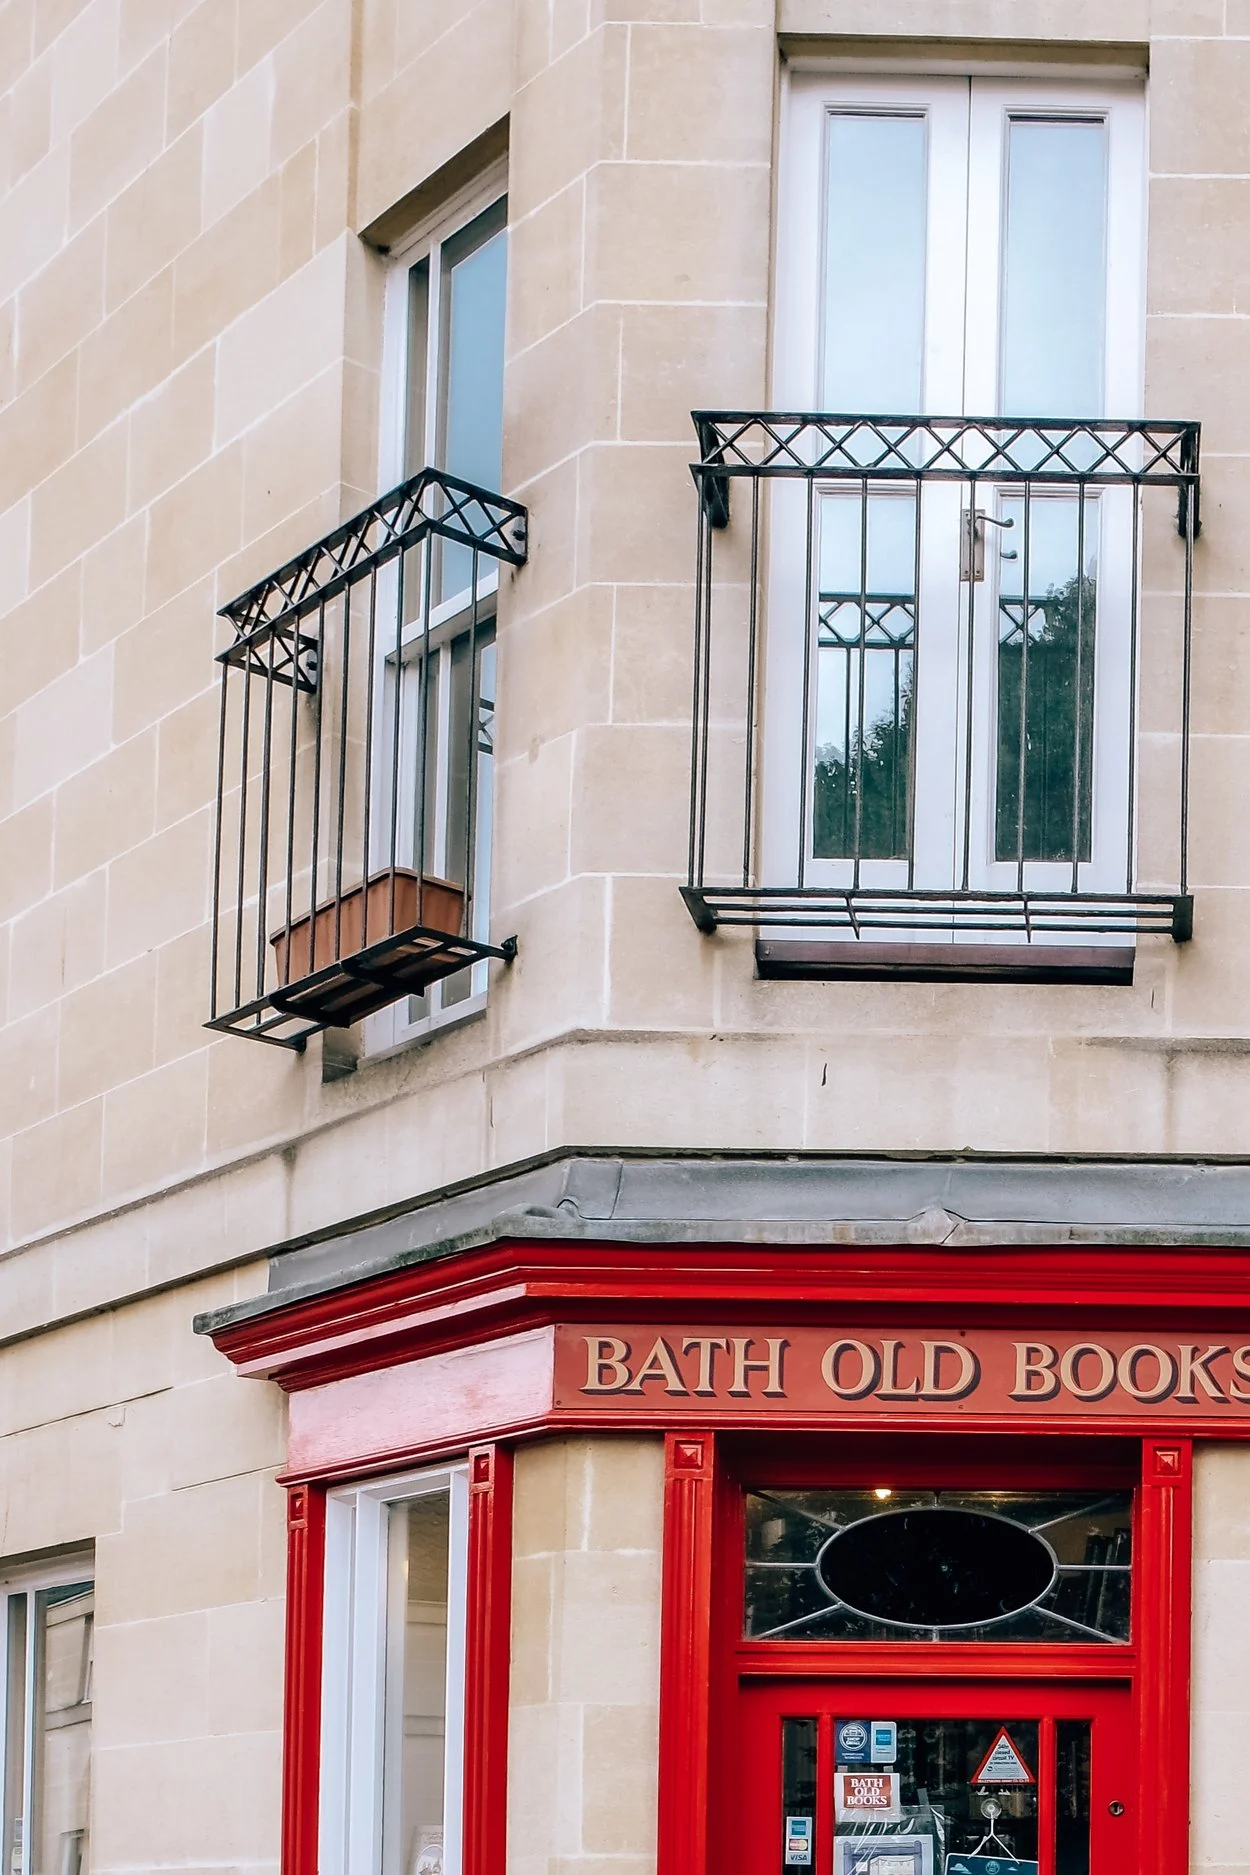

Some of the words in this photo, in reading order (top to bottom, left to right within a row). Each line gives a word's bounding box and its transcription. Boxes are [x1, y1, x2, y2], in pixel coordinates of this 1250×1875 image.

[578, 1336, 791, 1398] BATH
[820, 1338, 981, 1401] OLD
[850, 1778, 884, 1788] BATH
[854, 1787, 880, 1796] OLD
[847, 1795, 888, 1805] BOOKS
